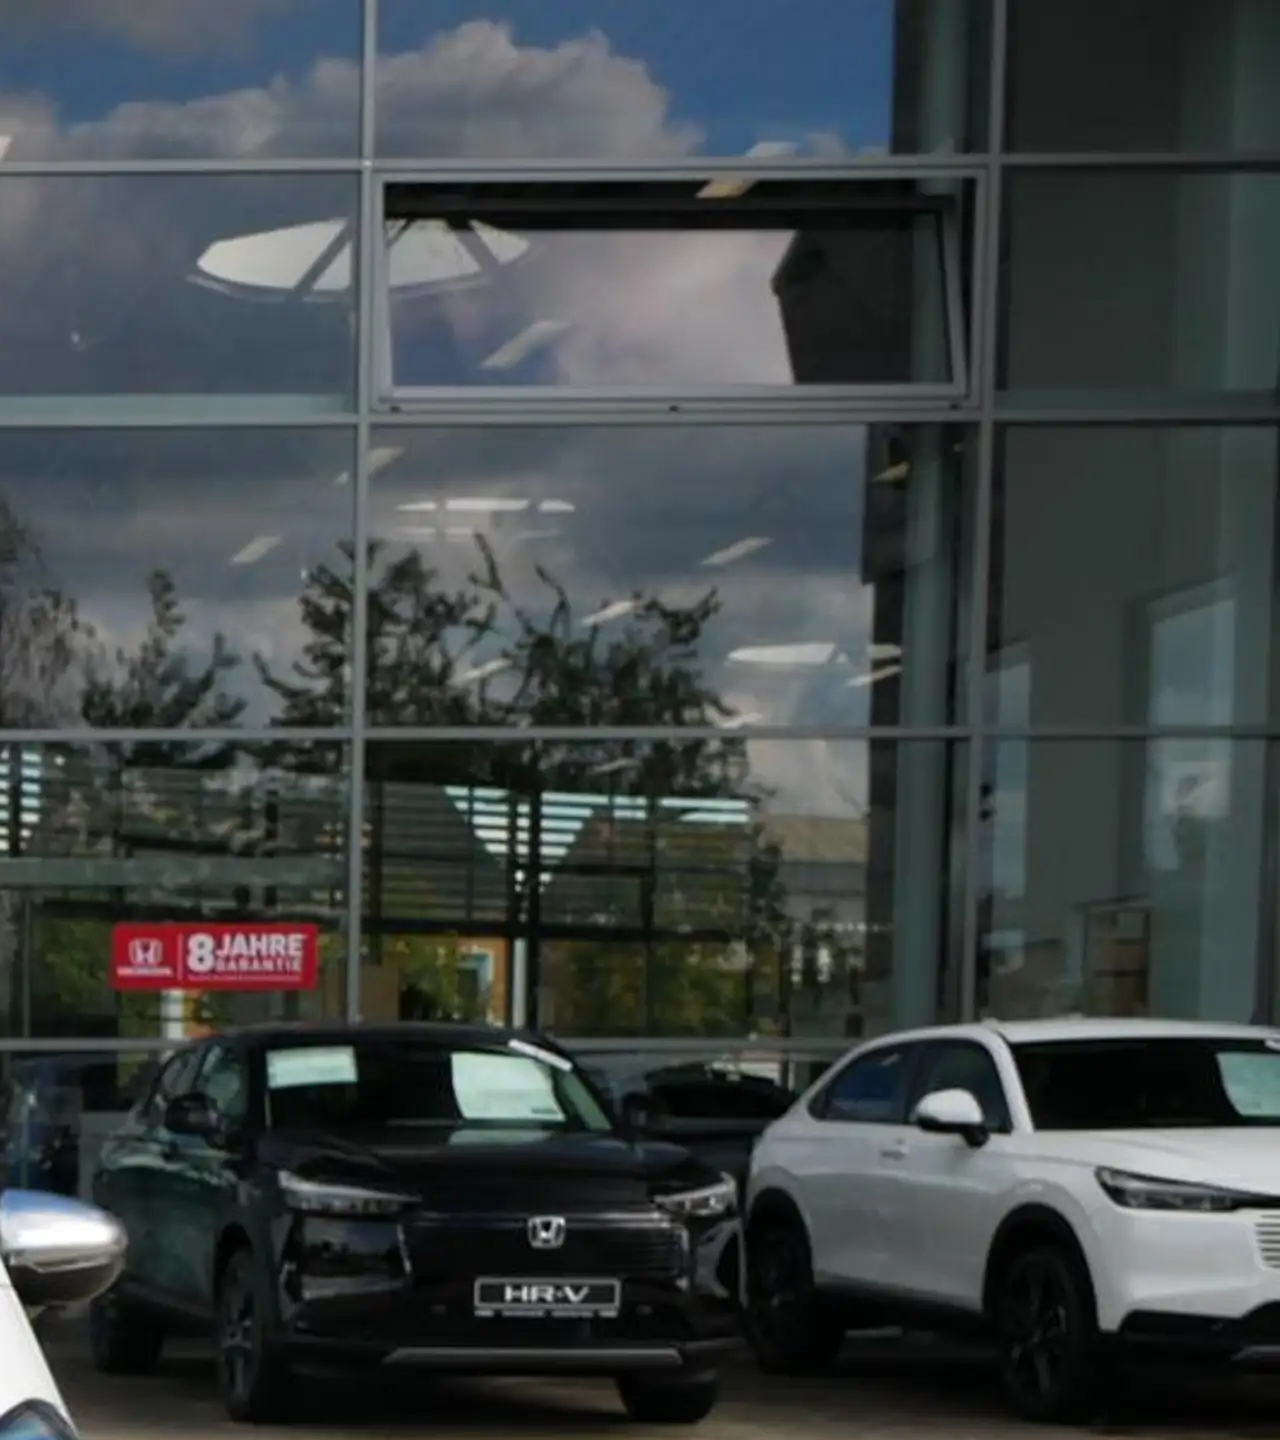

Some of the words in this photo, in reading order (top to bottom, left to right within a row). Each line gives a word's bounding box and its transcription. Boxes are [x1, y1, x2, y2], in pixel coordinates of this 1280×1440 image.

[187, 933, 214, 973] 8
[216, 934, 303, 957] JAHRE
[504, 1285, 589, 1302] HR-V
